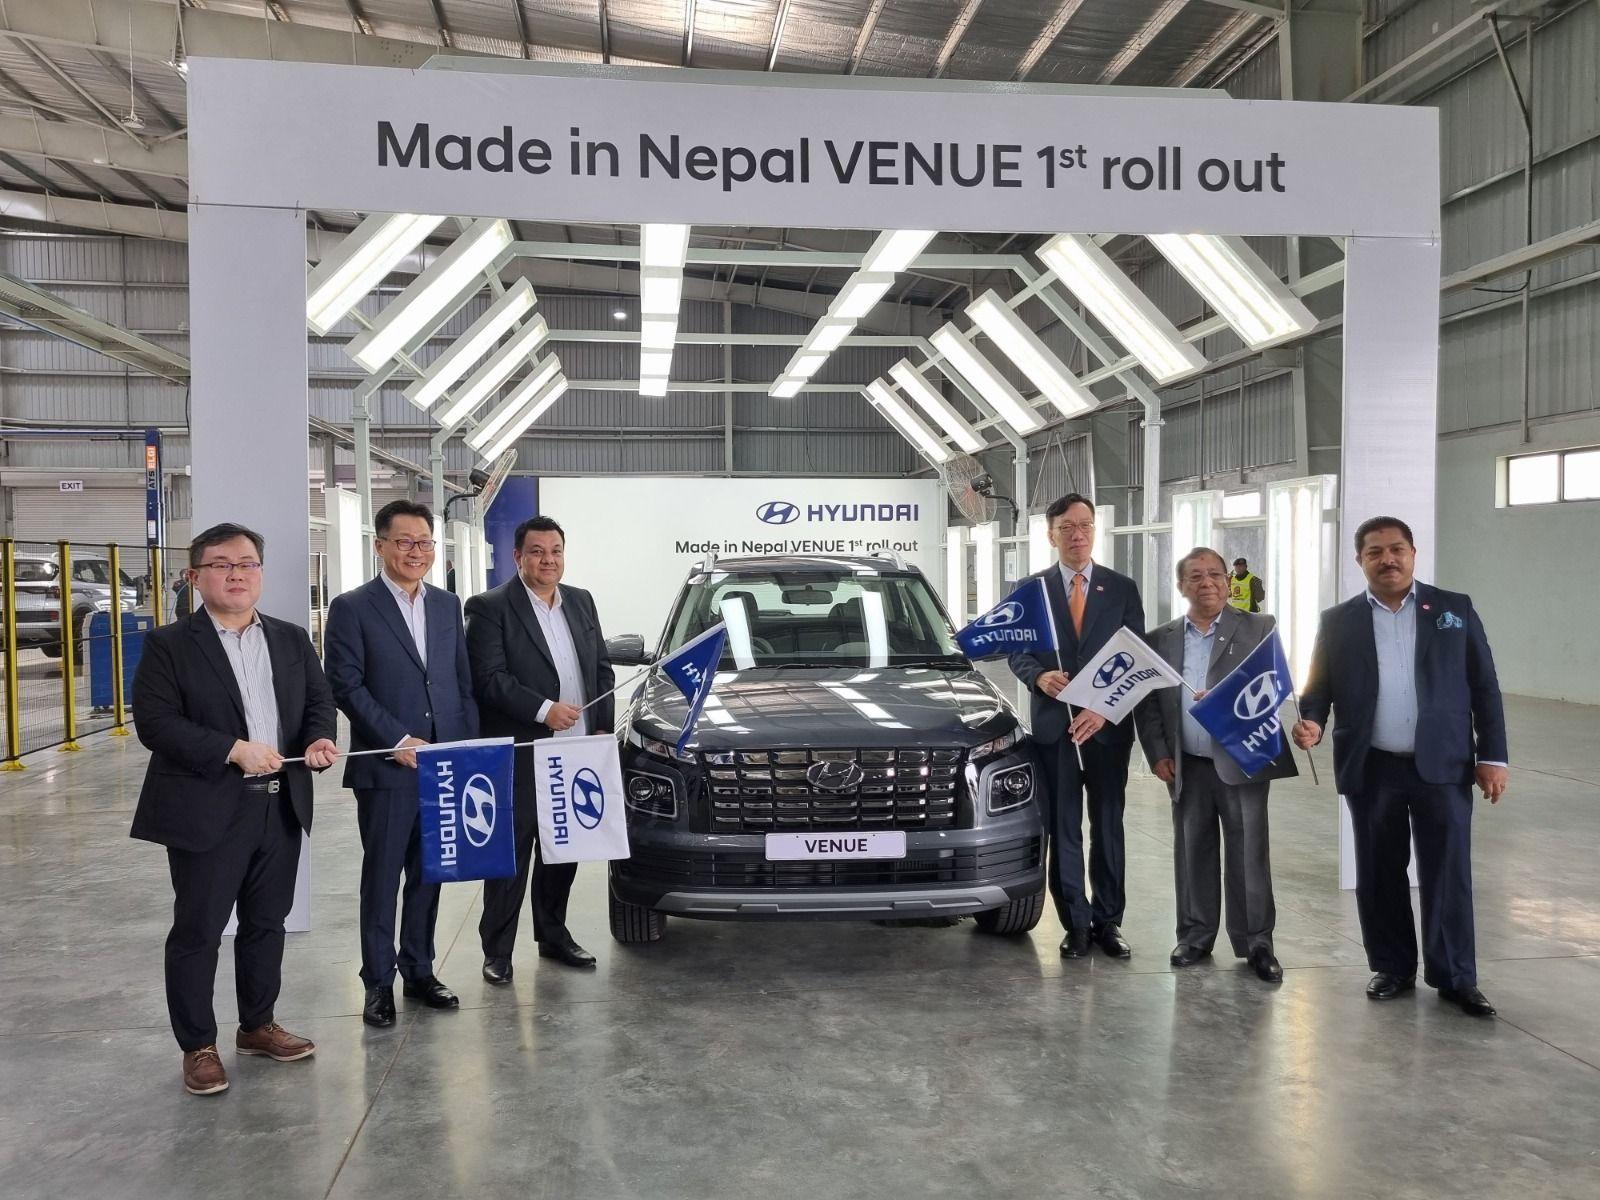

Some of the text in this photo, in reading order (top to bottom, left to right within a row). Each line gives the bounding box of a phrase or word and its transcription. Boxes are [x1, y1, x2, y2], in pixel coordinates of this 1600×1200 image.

[378, 121, 1286, 193] Made in Nepal VENUE 1st roll out
[61, 482, 81, 490] EXIT
[148, 470, 156, 489] ATS
[807, 504, 919, 522] HYUNDAI
[675, 539, 919, 556] Made in Nepal VENUE 1st roll out
[971, 629, 1039, 647] HYUNDAI
[1104, 667, 1163, 707] HYUNDAI
[547, 756, 569, 845] HYUNDAI
[436, 760, 457, 866] HYUNDAI
[804, 838, 868, 853] VENUE
